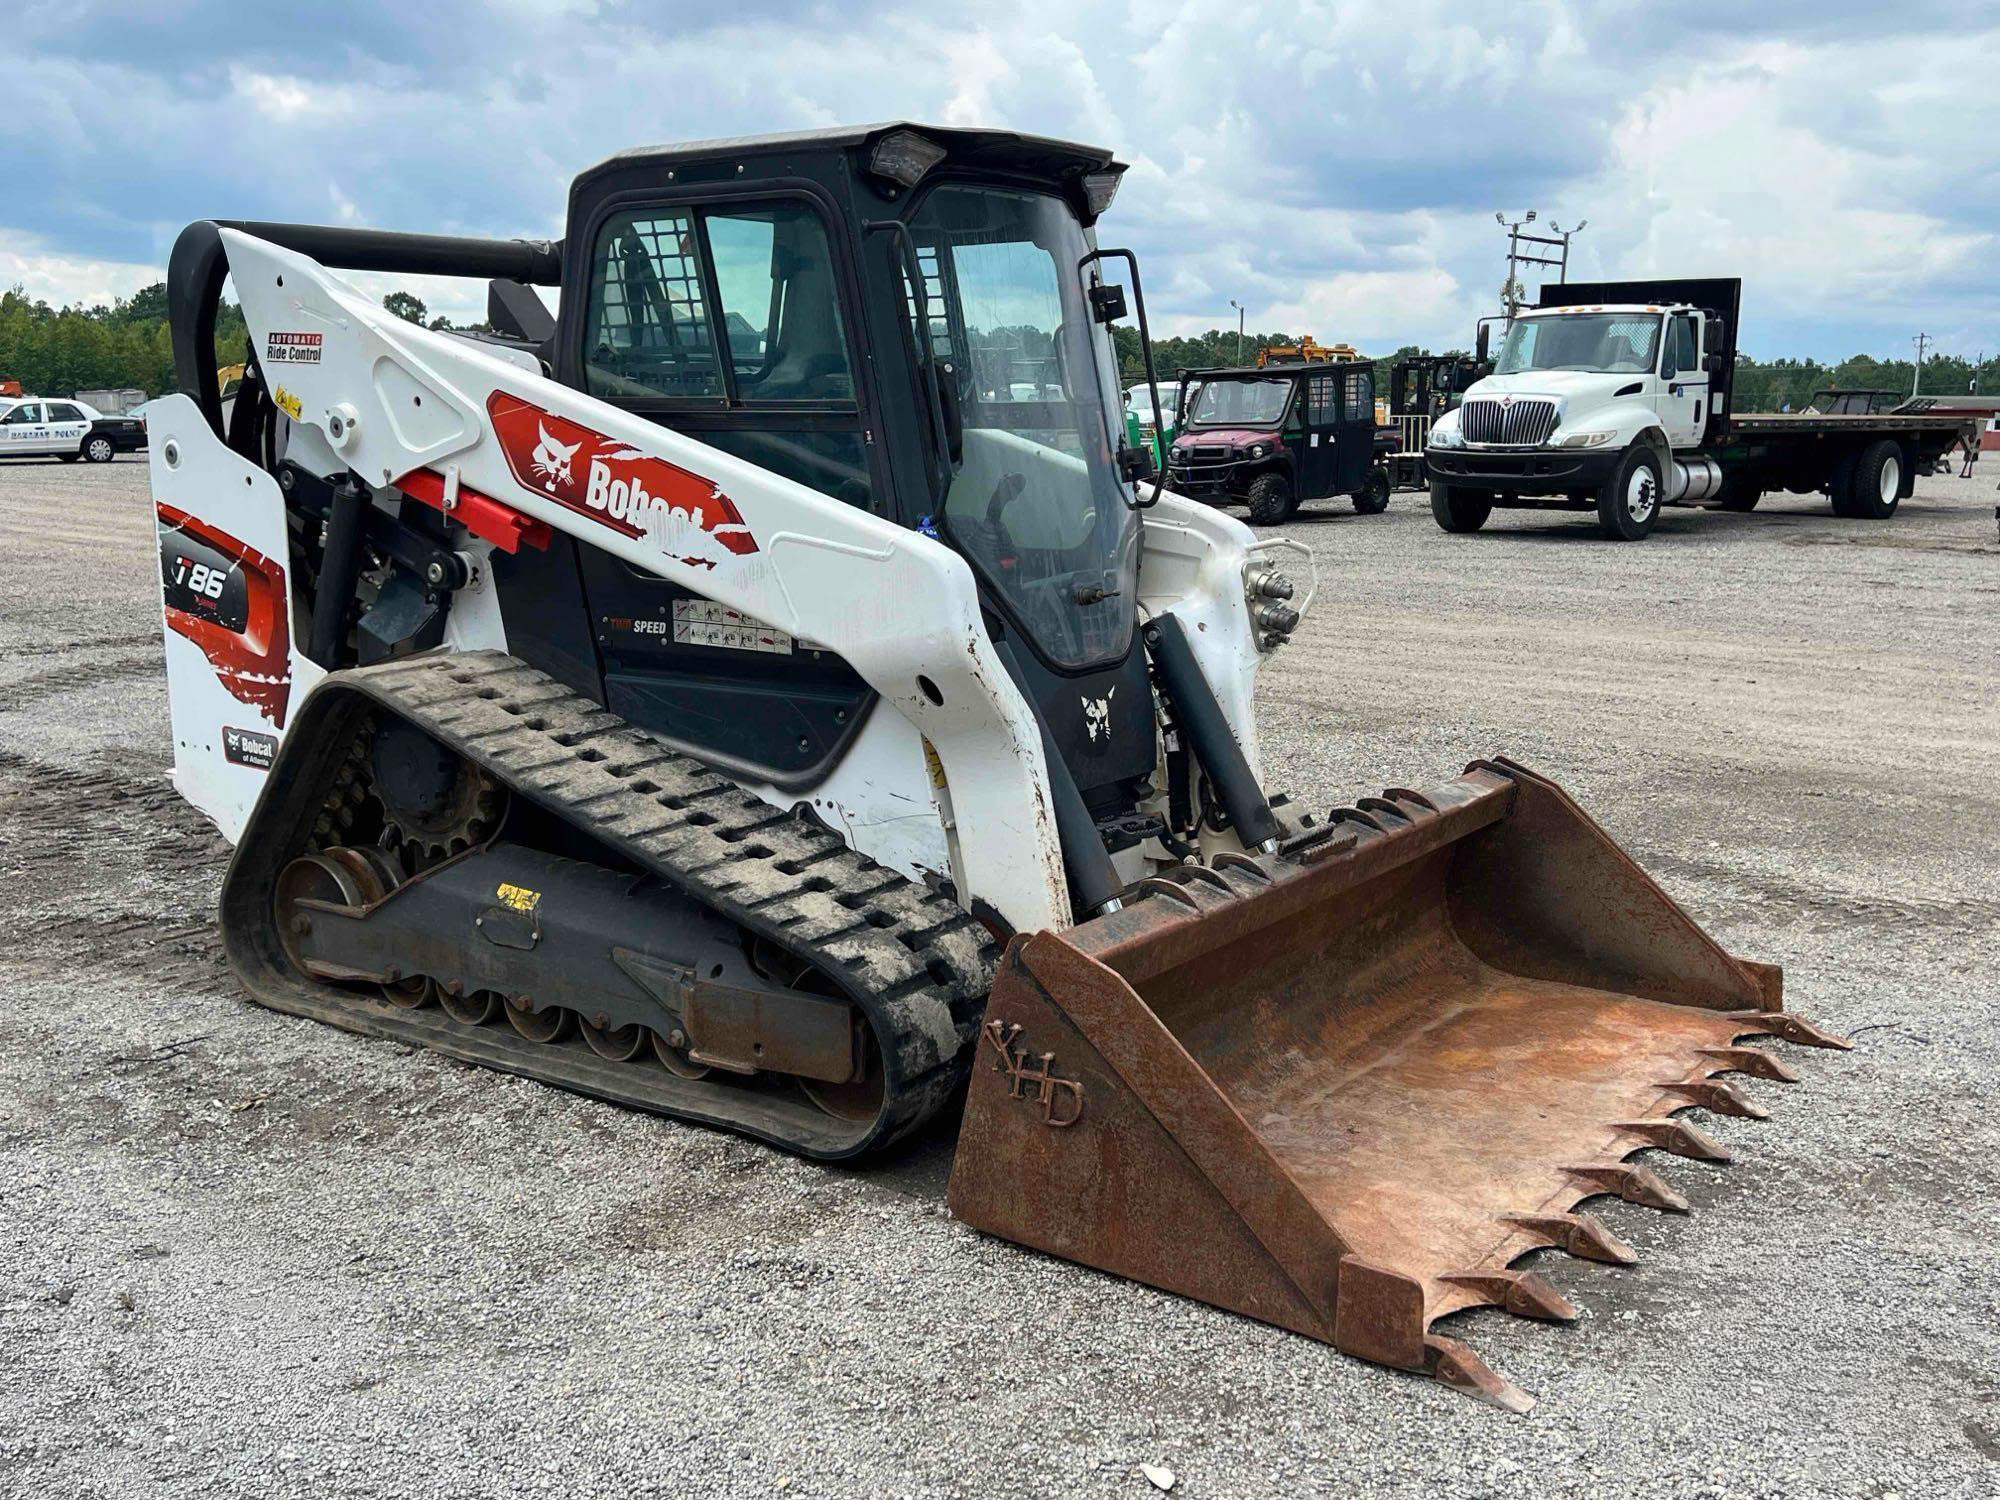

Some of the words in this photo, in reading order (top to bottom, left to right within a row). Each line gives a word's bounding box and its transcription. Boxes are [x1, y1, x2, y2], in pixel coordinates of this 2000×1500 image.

[270, 334, 321, 345] AUTOMATIC
[267, 345, 287, 360] Ride
[289, 346, 321, 361] Control
[633, 620, 667, 634] SPEED
[241, 737, 273, 757] Bobcat
